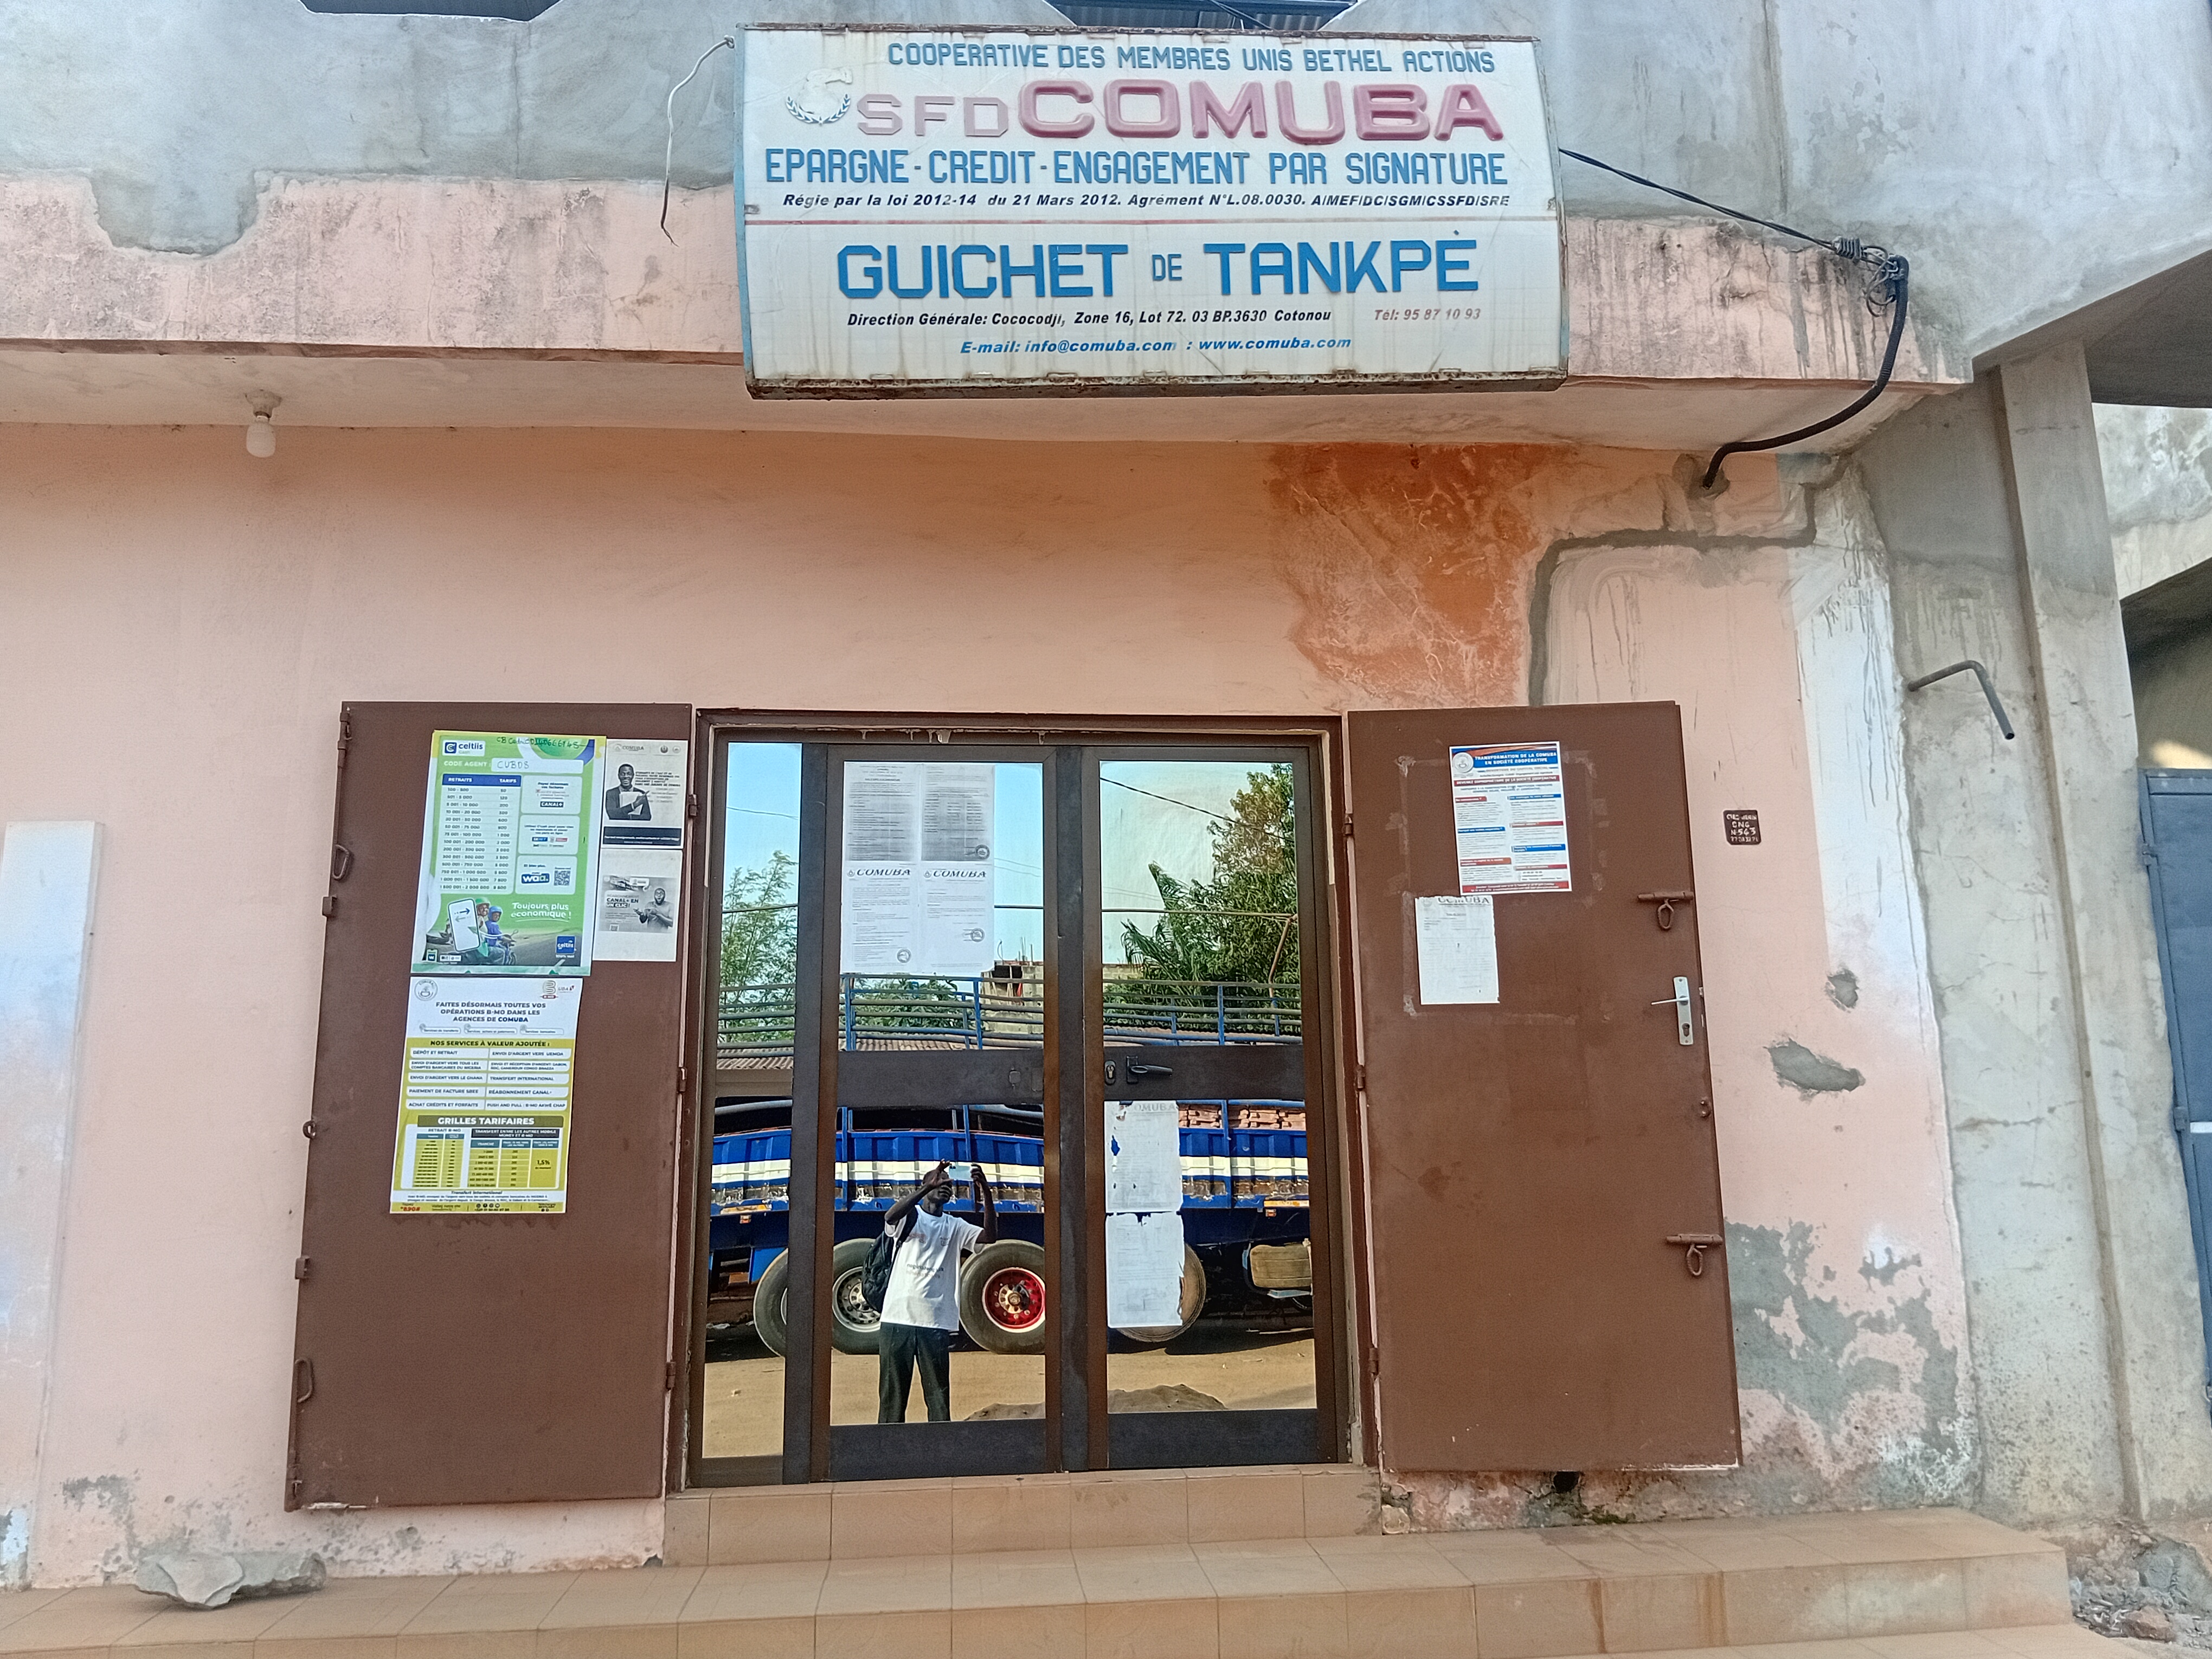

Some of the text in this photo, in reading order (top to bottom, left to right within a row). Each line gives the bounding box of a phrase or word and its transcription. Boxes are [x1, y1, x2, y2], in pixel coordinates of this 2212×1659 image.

[889, 42, 1495, 73] COOPERATIVE DES MEMBRES UNIS BETHEL ACTIONS
[857, 79, 1504, 145] SFD COMUBA
[766, 149, 910, 183] EPARGNE
[929, 150, 1036, 183] CREDIT
[1054, 151, 1249, 184] ENGAGEMENT
[1270, 152, 1327, 184] PAR
[1346, 153, 1508, 185] SIGNATURE
[783, 194, 829, 208] Régie
[834, 196, 862, 209] par
[867, 194, 882, 206] la
[887, 194, 908, 206] loi
[913, 194, 977, 207] 2012-14
[987, 195, 1007, 207] du
[1013, 195, 1031, 207] 21
[1037, 195, 1075, 207] Mars
[1080, 195, 1122, 207] 2012.
[1128, 194, 1205, 208] Agrément
[838, 244, 1128, 298] GUICHET
[1152, 254, 1182, 281] DE
[847, 308, 1481, 327] Direction Générale: Cococodji, Zone 16, Lot 72. 03 BP.3630 Cotonou Tél: 95 87 10 93
[960, 340, 1021, 353] E-mail:
[1198, 337, 1352, 351] www.comuba.com
[857, 869, 911, 877] COMUBA
[511, 909, 566, 919] économique
[512, 902, 569, 911] Toujours plus
